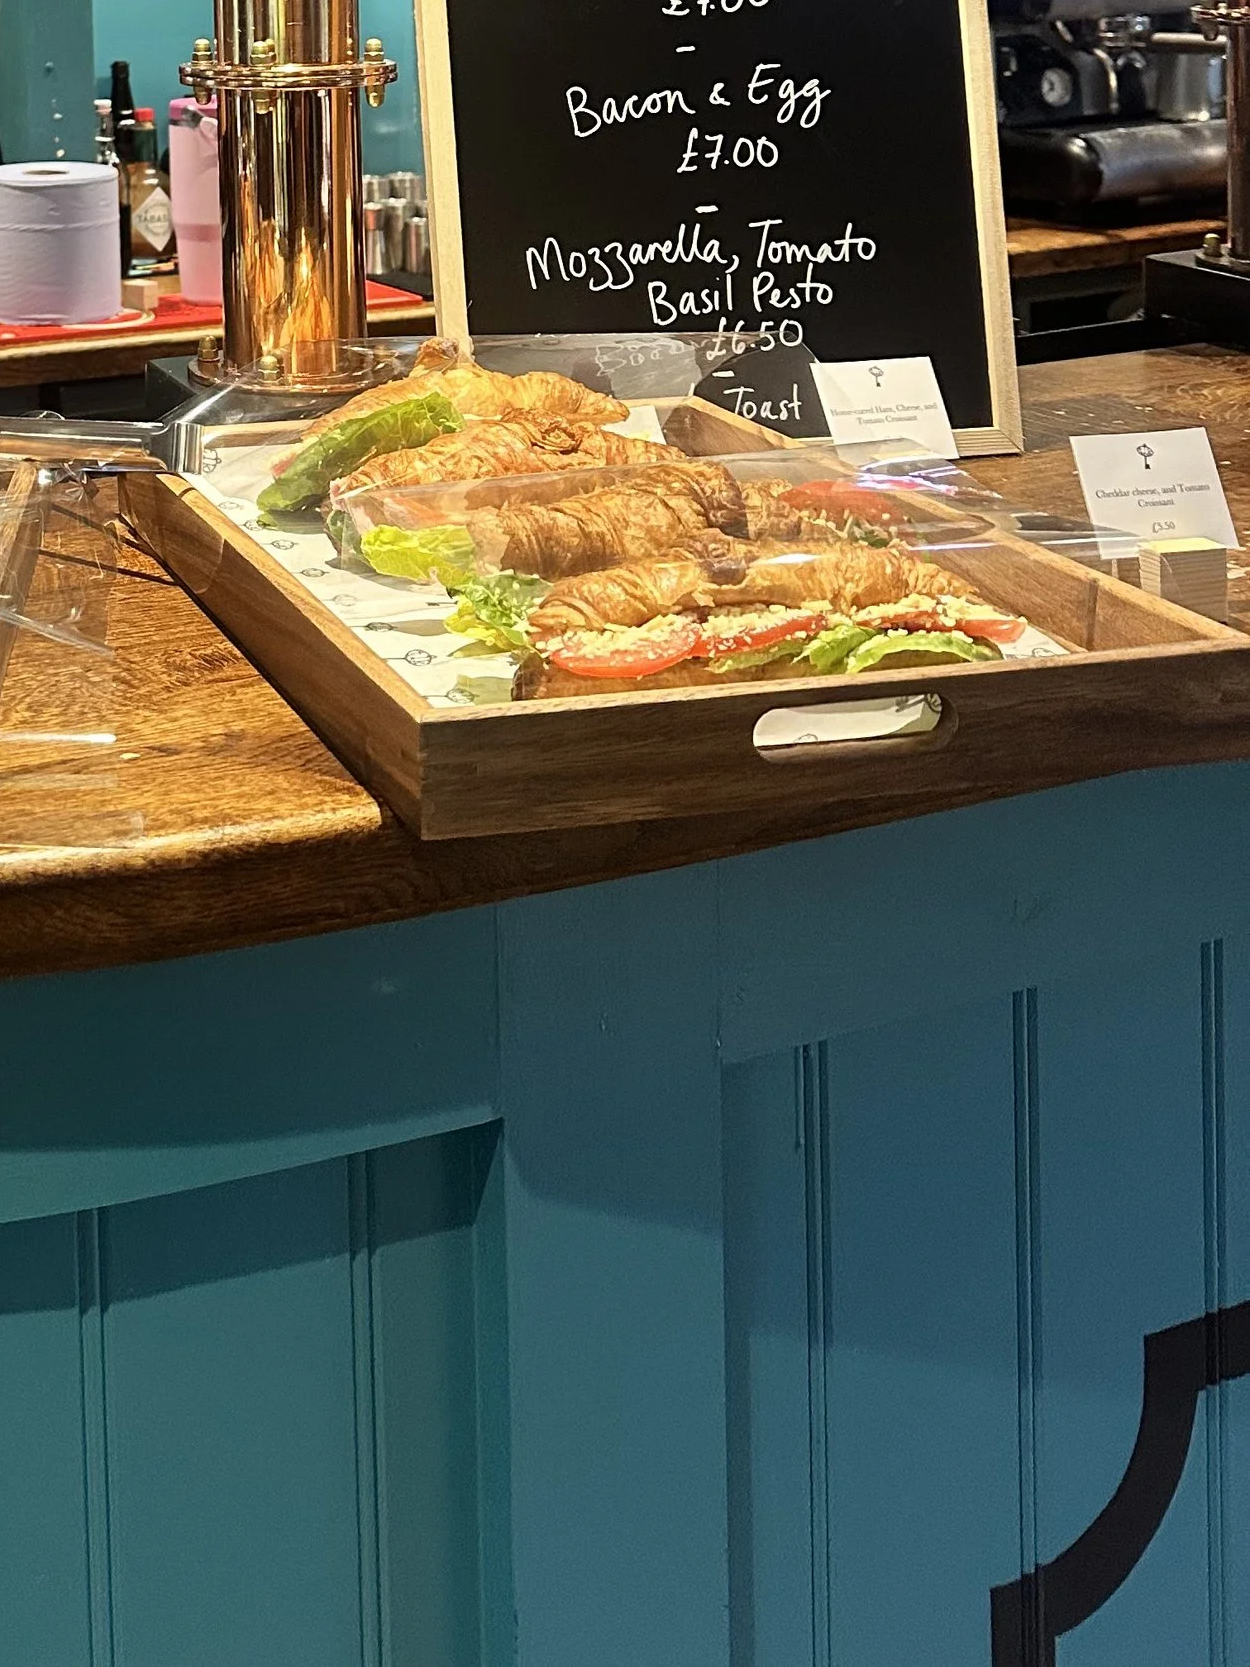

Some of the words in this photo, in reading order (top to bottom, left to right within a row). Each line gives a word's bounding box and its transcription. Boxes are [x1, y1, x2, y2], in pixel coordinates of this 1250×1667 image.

[565, 85, 697, 138] Bacon
[708, 82, 732, 107] &
[748, 63, 832, 129] Egg
[676, 127, 780, 174] £7.00
[525, 222, 741, 292] Mozzarella,
[748, 218, 877, 269] Tomato
[647, 276, 733, 326] Basil
[752, 262, 834, 313] Pesto
[706, 316, 803, 361] £6.50
[722, 383, 803, 421] Toast
[924, 401, 938, 410] and
[1095, 488, 1130, 499] Cheddar
[1162, 484, 1177, 494] and
[1177, 483, 1211, 493] Tomato
